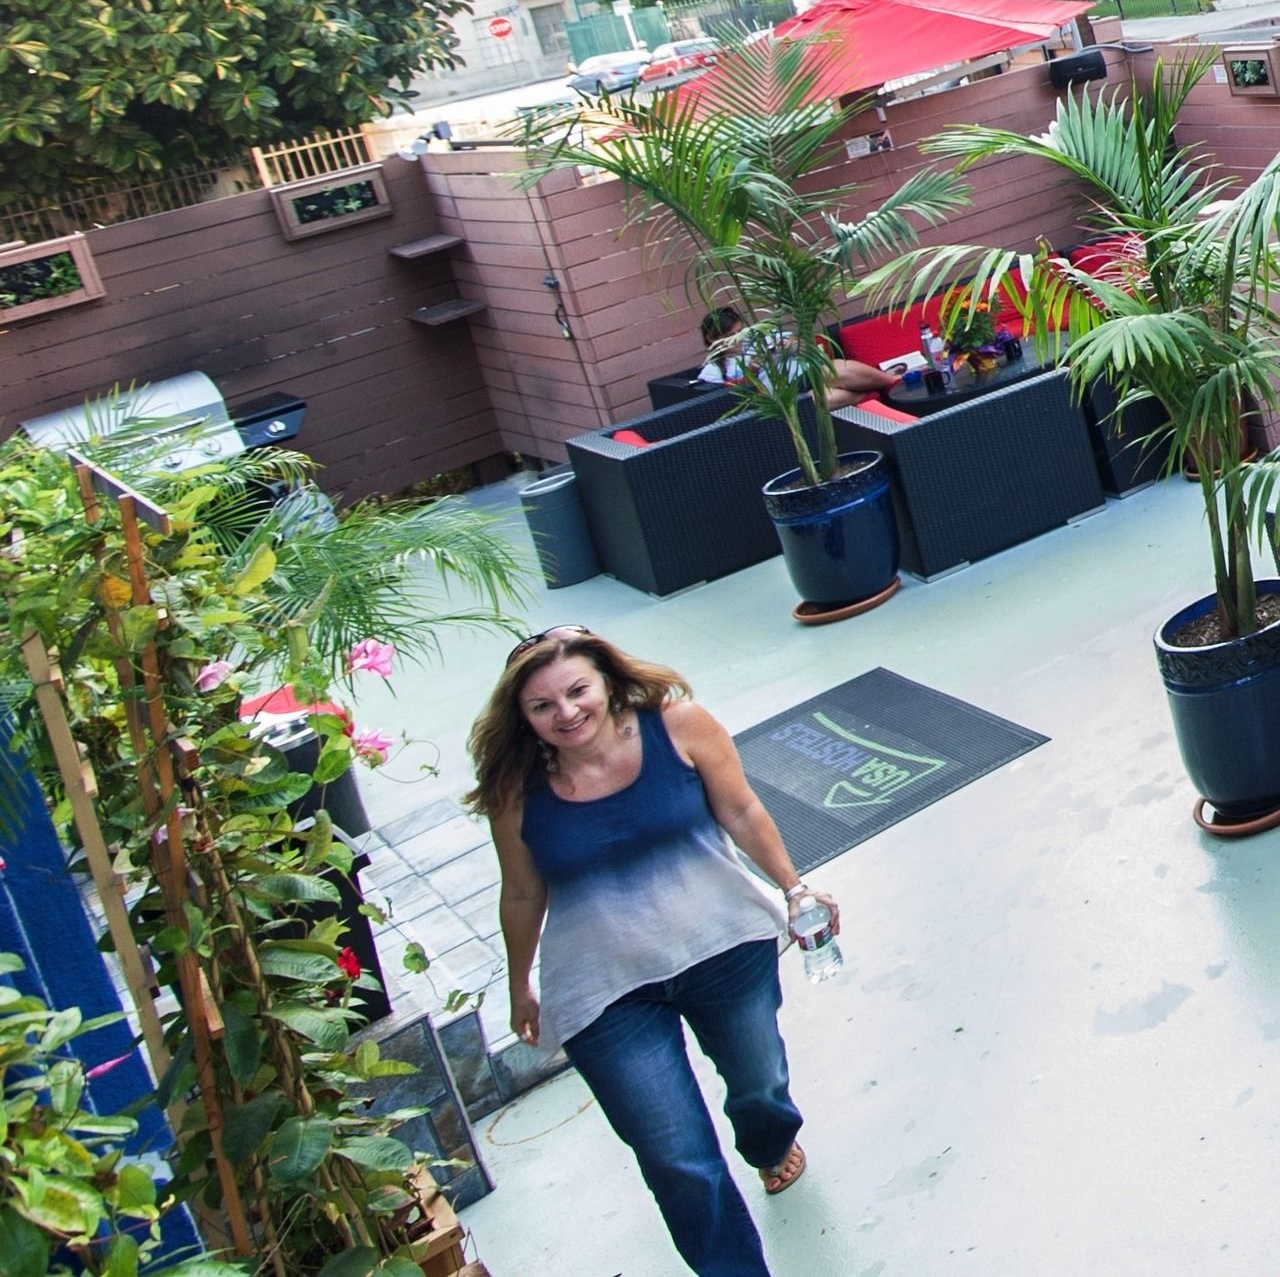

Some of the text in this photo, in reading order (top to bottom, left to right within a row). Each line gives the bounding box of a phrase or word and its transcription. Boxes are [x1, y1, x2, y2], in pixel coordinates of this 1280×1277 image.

[489, 23, 512, 33] STOP
[769, 722, 869, 773] HOSTELS
[850, 756, 911, 791] USA
